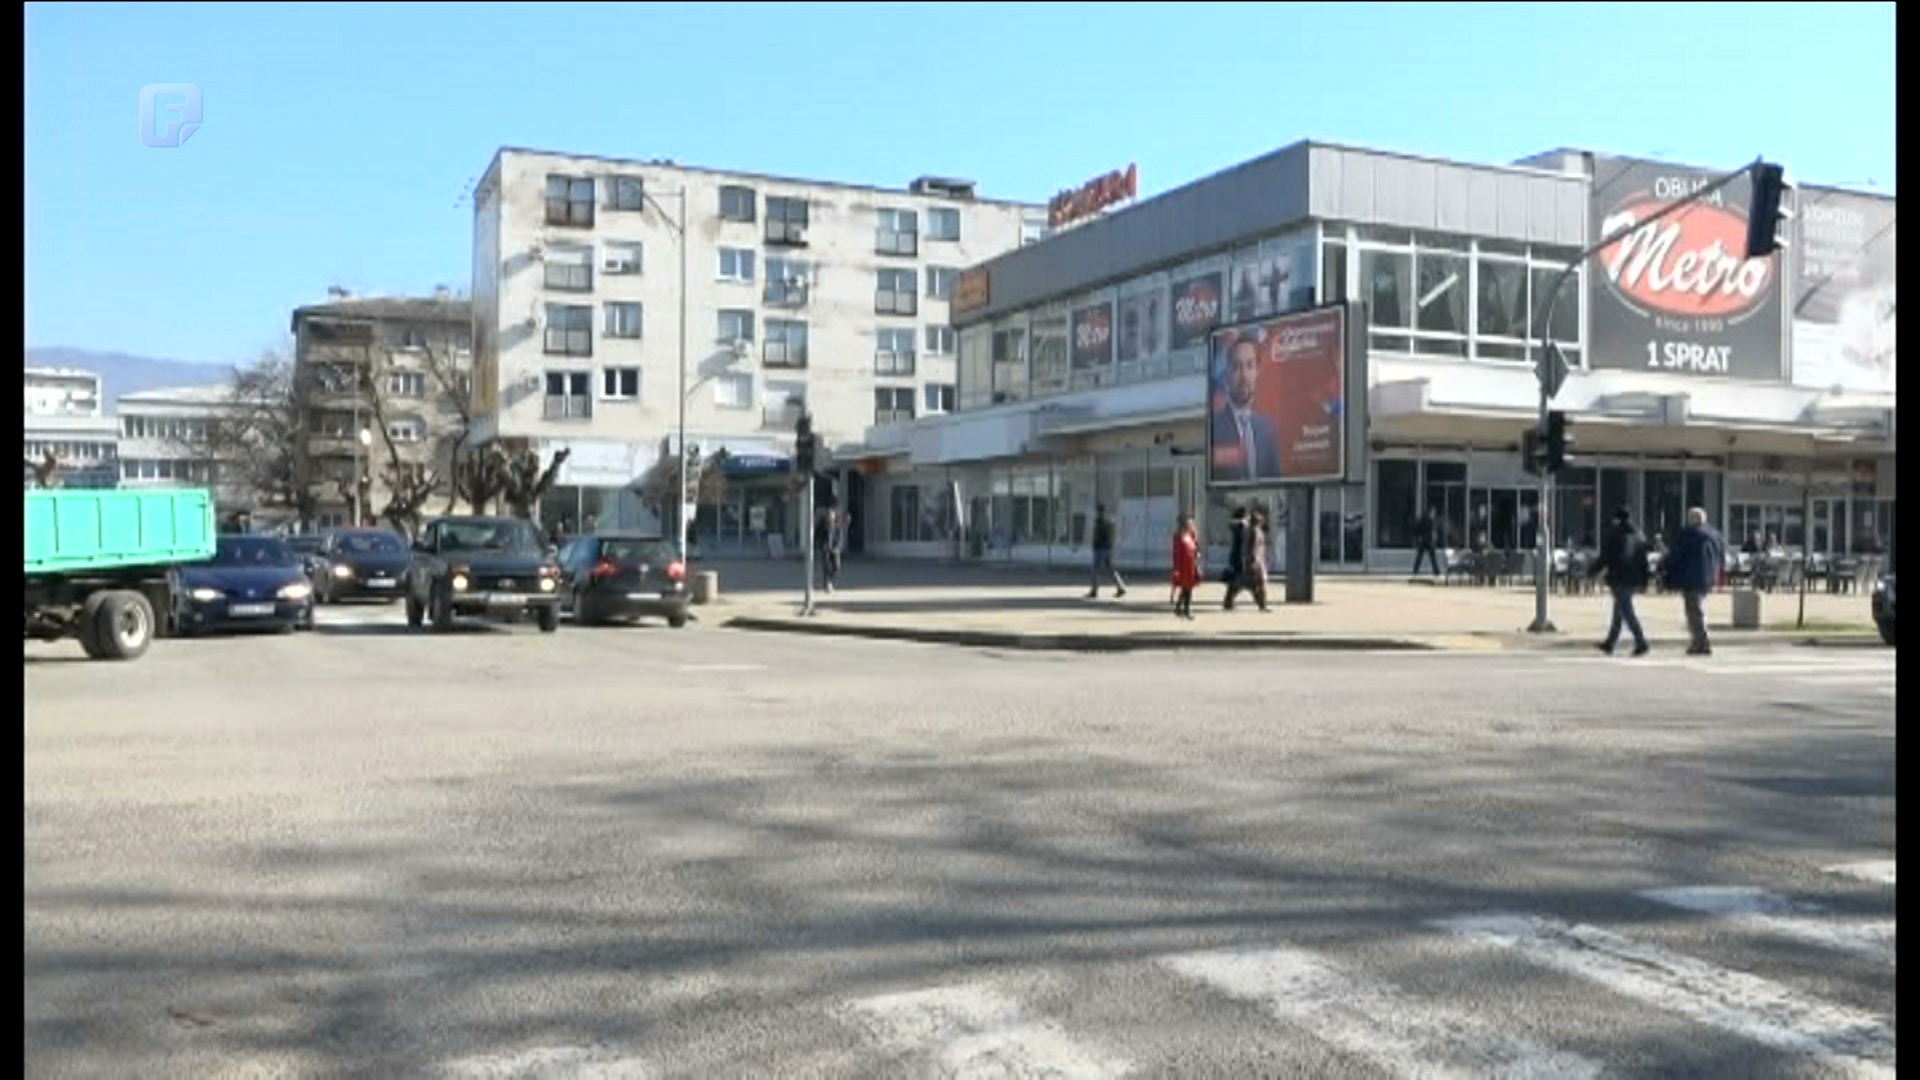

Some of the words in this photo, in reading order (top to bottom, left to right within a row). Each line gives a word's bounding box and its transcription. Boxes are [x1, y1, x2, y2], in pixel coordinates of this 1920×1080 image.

[1601, 209, 1768, 299] Metro
[1646, 339, 1660, 367] 1
[1663, 341, 1733, 373] SPRAT
